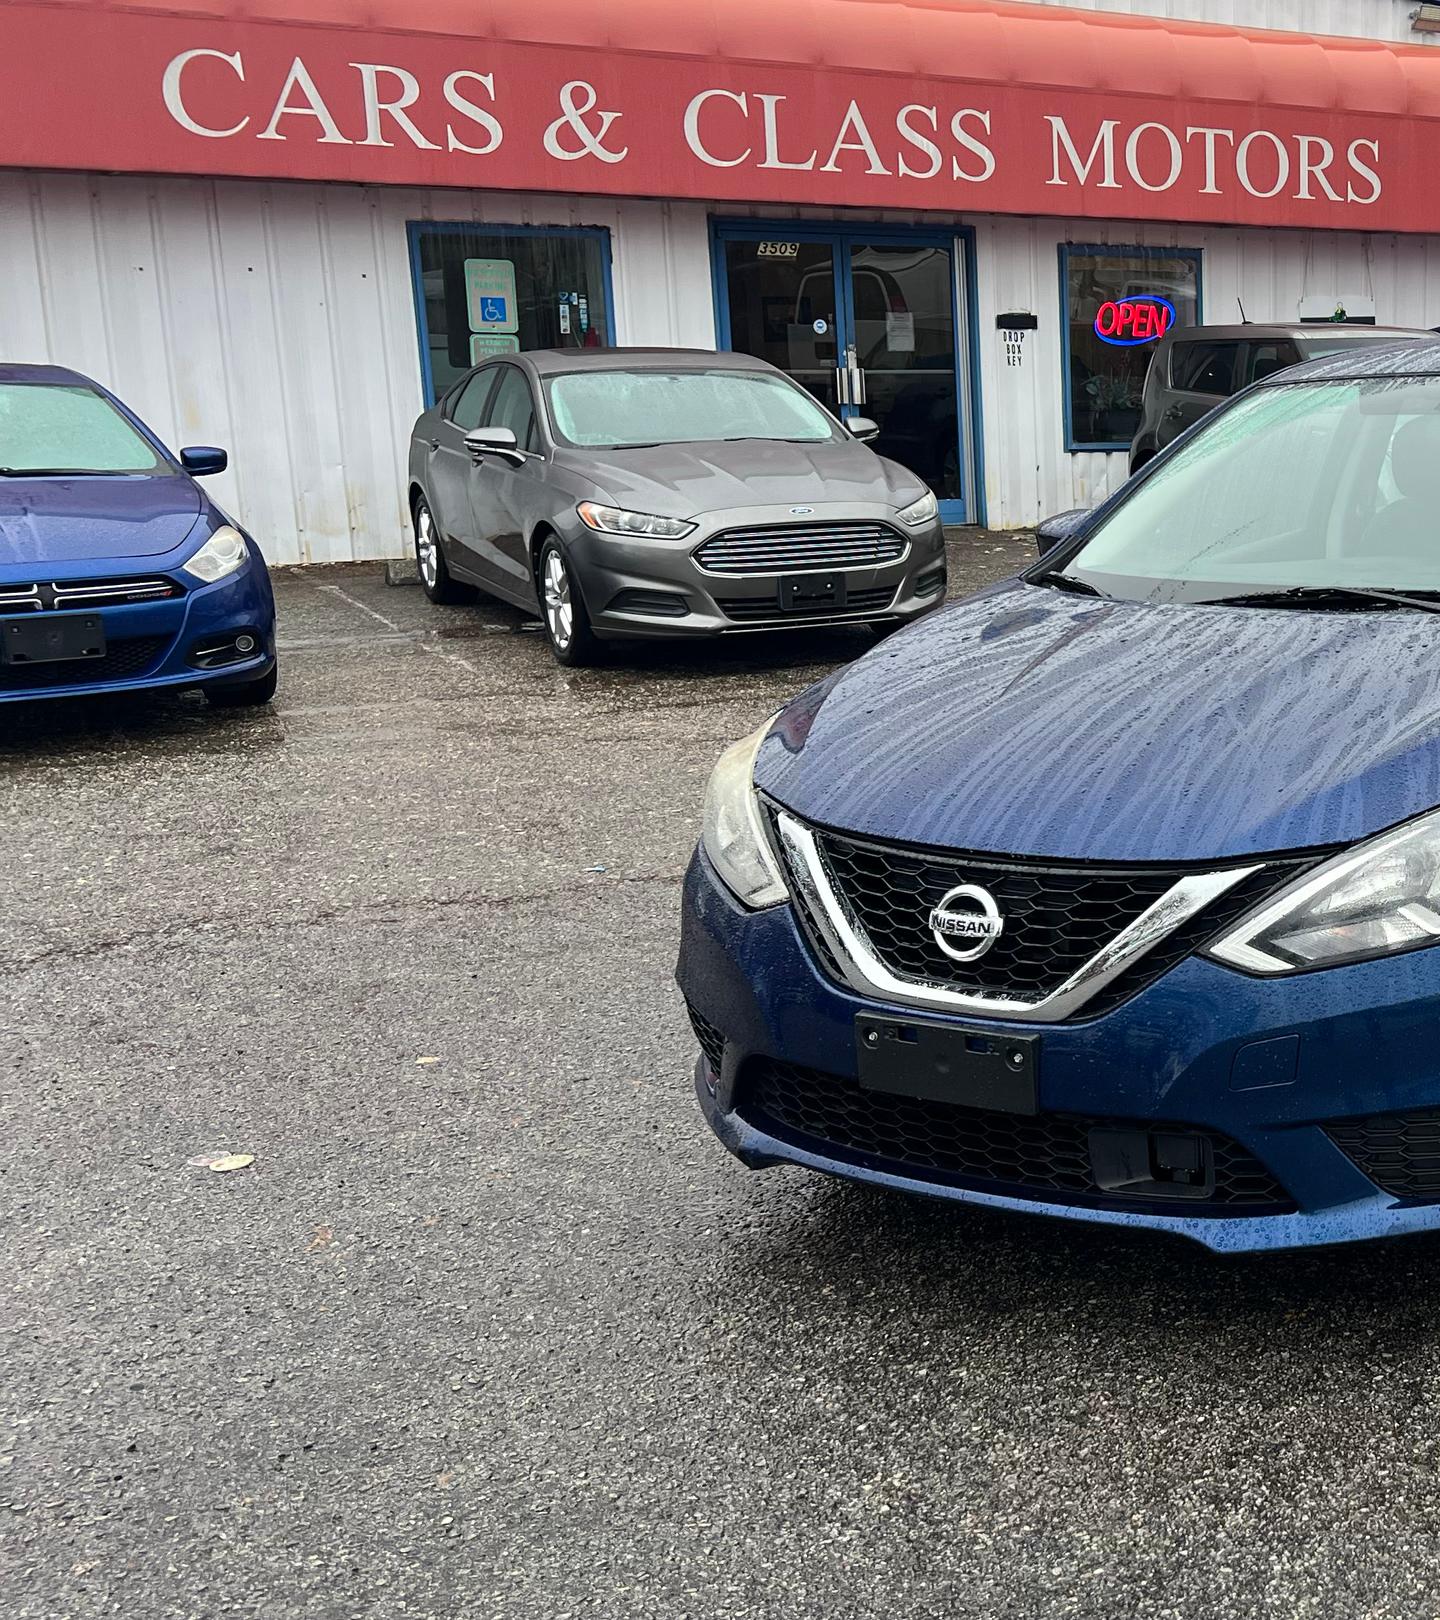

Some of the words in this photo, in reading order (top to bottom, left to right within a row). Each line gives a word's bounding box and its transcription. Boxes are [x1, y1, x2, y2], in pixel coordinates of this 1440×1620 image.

[162, 48, 504, 155] CARS
[543, 80, 628, 163] &
[683, 89, 996, 182] CLASS
[1045, 115, 1382, 205] MOTORS
[758, 242, 799, 256] 3509
[1096, 301, 1168, 338] OPEN
[1003, 331, 1025, 344] DROP
[1006, 344, 1022, 355] BOX
[1006, 355, 1022, 367] KEY
[933, 916, 991, 934] NISSAN
